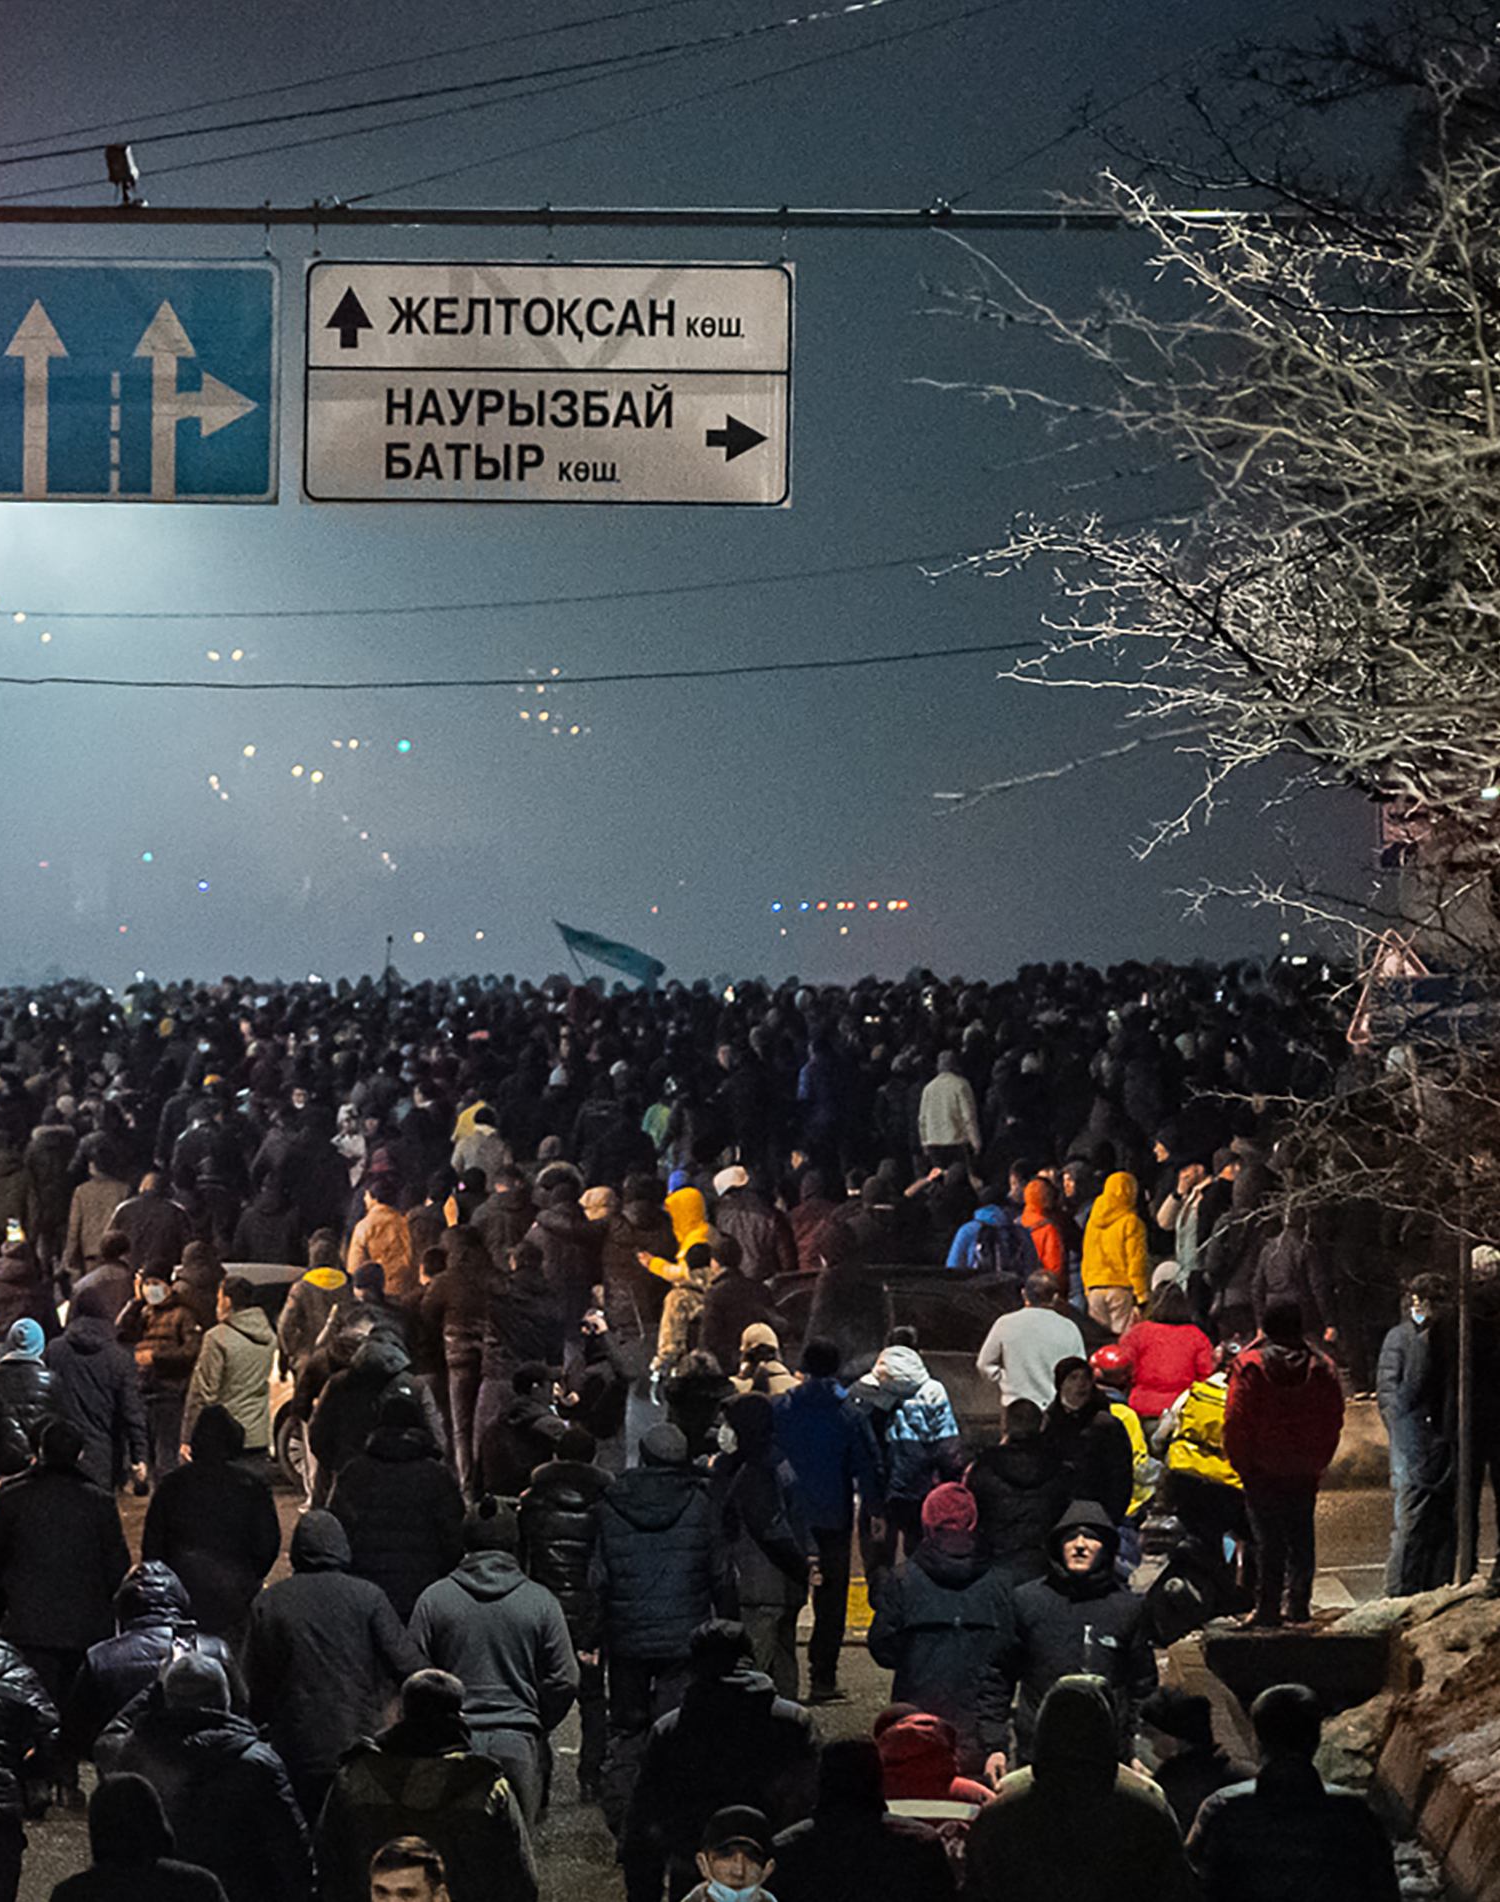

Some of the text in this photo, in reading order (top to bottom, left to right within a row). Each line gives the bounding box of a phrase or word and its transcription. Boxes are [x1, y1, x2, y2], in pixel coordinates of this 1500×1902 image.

[388, 296, 746, 343] ЖЕЛТОҚСАН көш.
[384, 383, 674, 429] НАУРЫЗБАЙ
[384, 442, 621, 484] БАТЫР көш.
